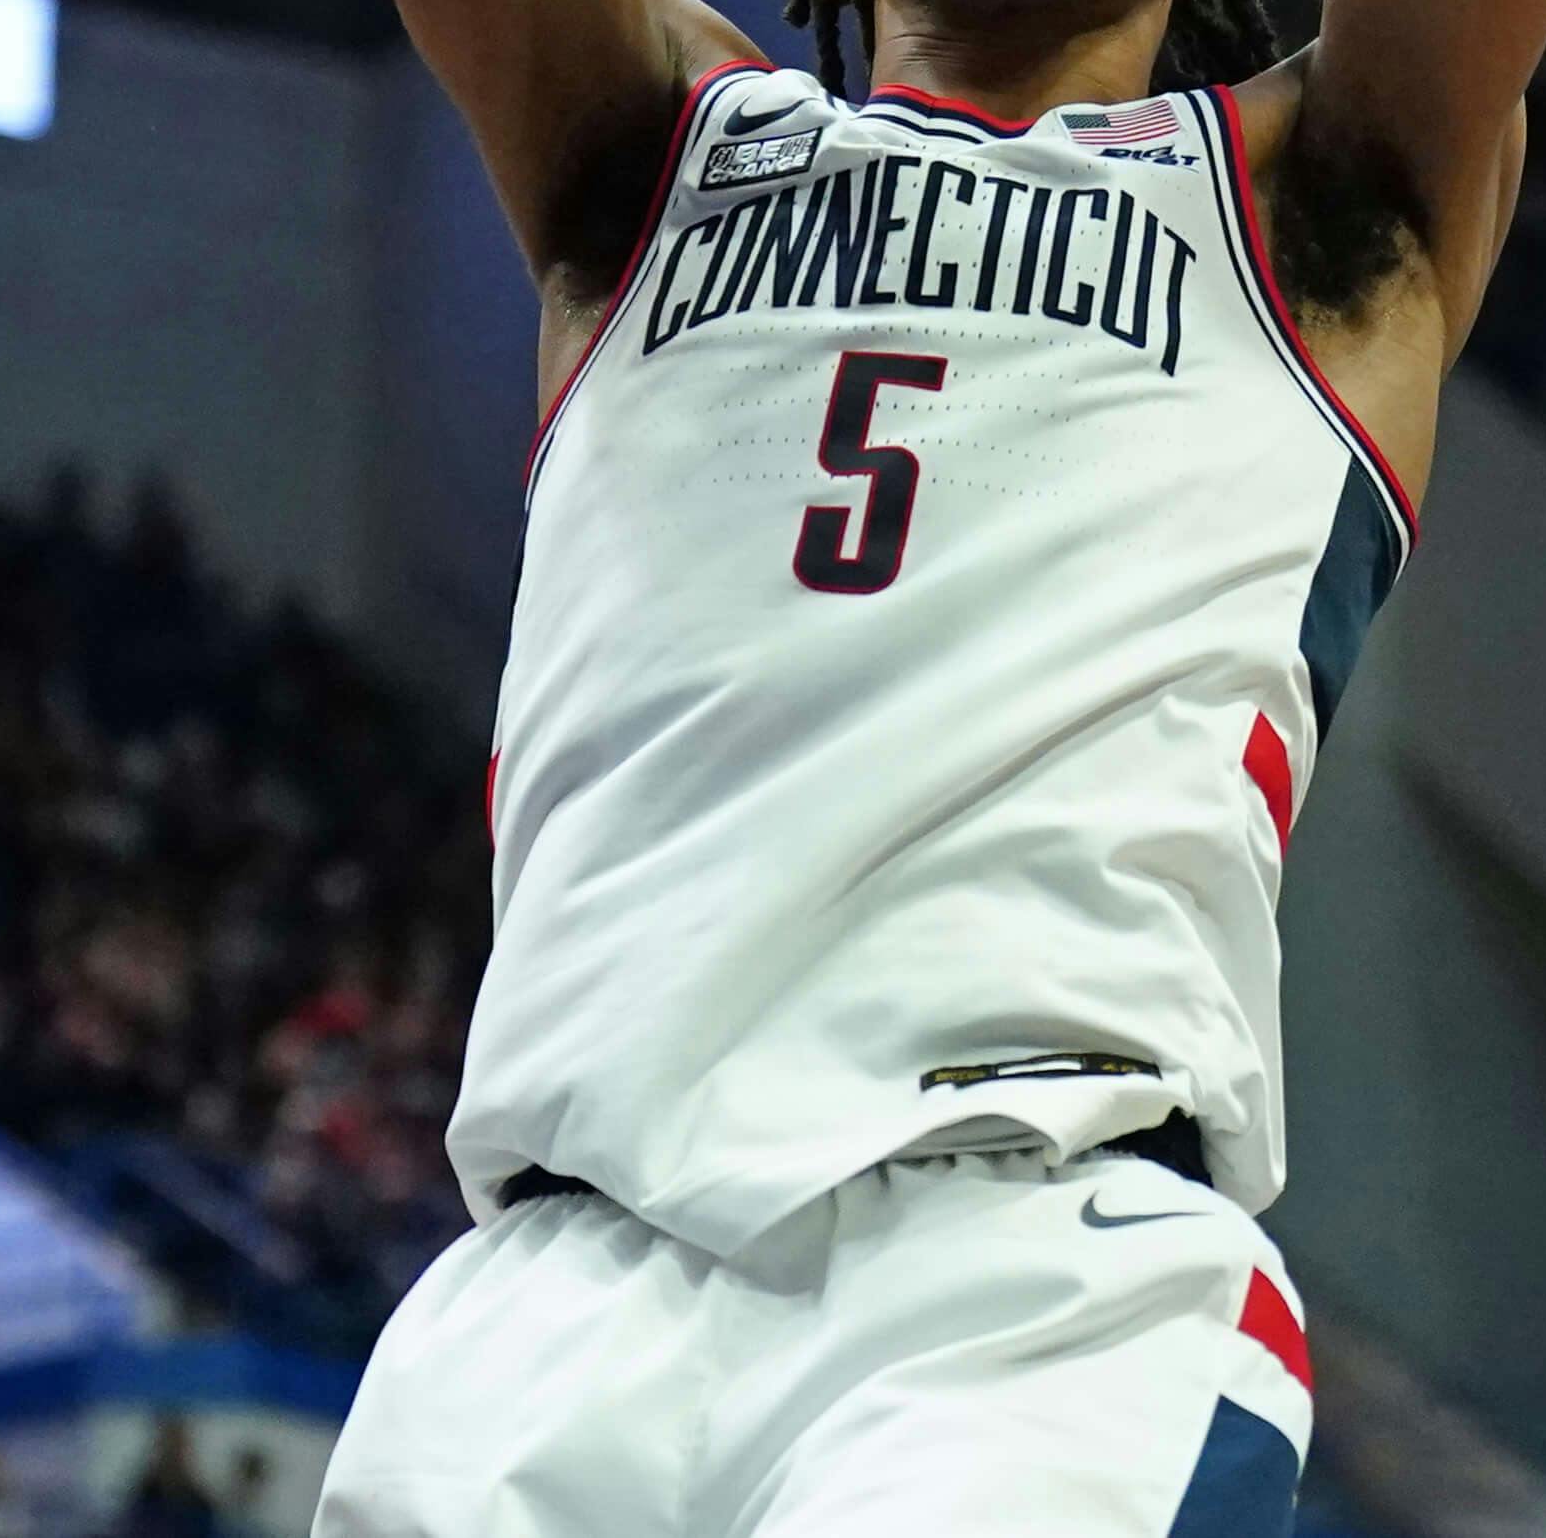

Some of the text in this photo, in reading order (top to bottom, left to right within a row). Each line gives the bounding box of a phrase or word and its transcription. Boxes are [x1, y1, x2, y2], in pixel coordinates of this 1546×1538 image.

[642, 156, 1197, 377] CONNECTICUT
[704, 152, 810, 185] CHANGE
[792, 350, 949, 595] 5
